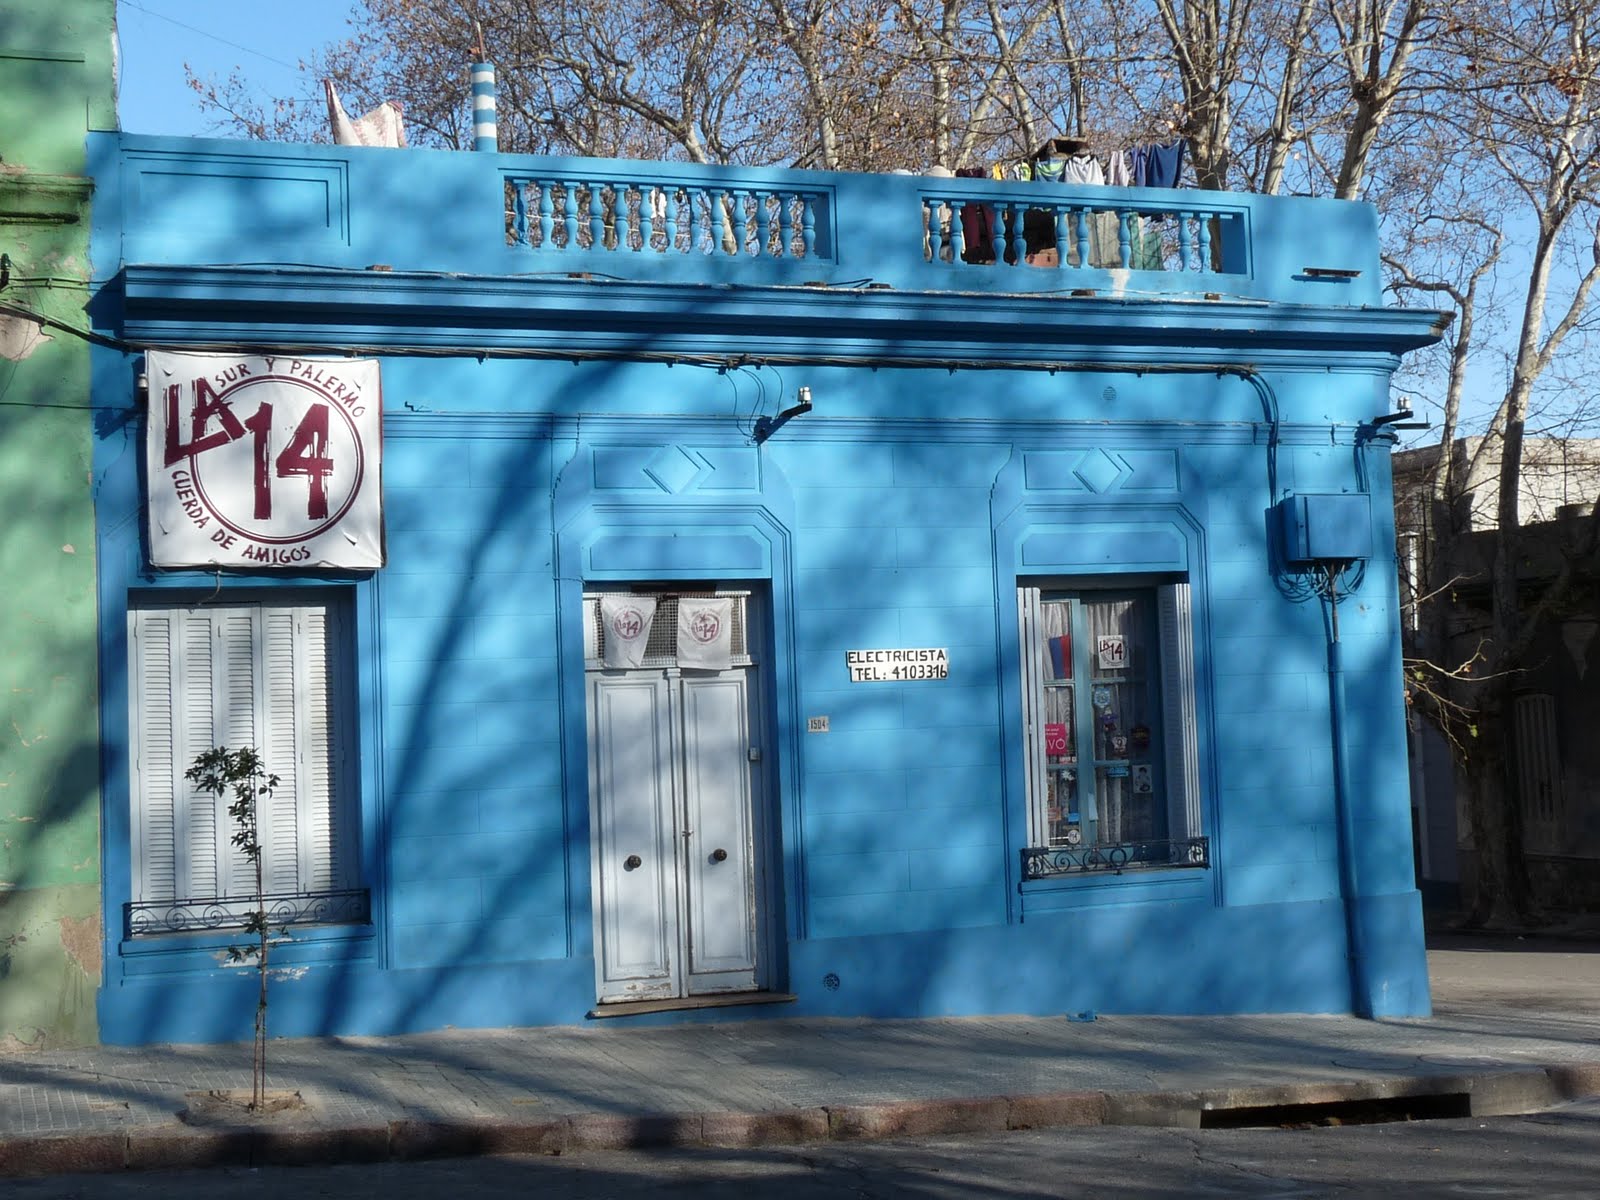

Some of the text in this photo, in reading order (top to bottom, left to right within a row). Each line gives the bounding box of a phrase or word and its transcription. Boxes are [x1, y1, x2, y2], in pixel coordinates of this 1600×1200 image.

[215, 358, 366, 418] SUR Y PALERMO
[164, 377, 334, 520] LA 14
[171, 470, 311, 563] CUERDA DE AMIGOS
[848, 649, 946, 663] ELECTRICISTA
[892, 664, 948, 679] 4103316
